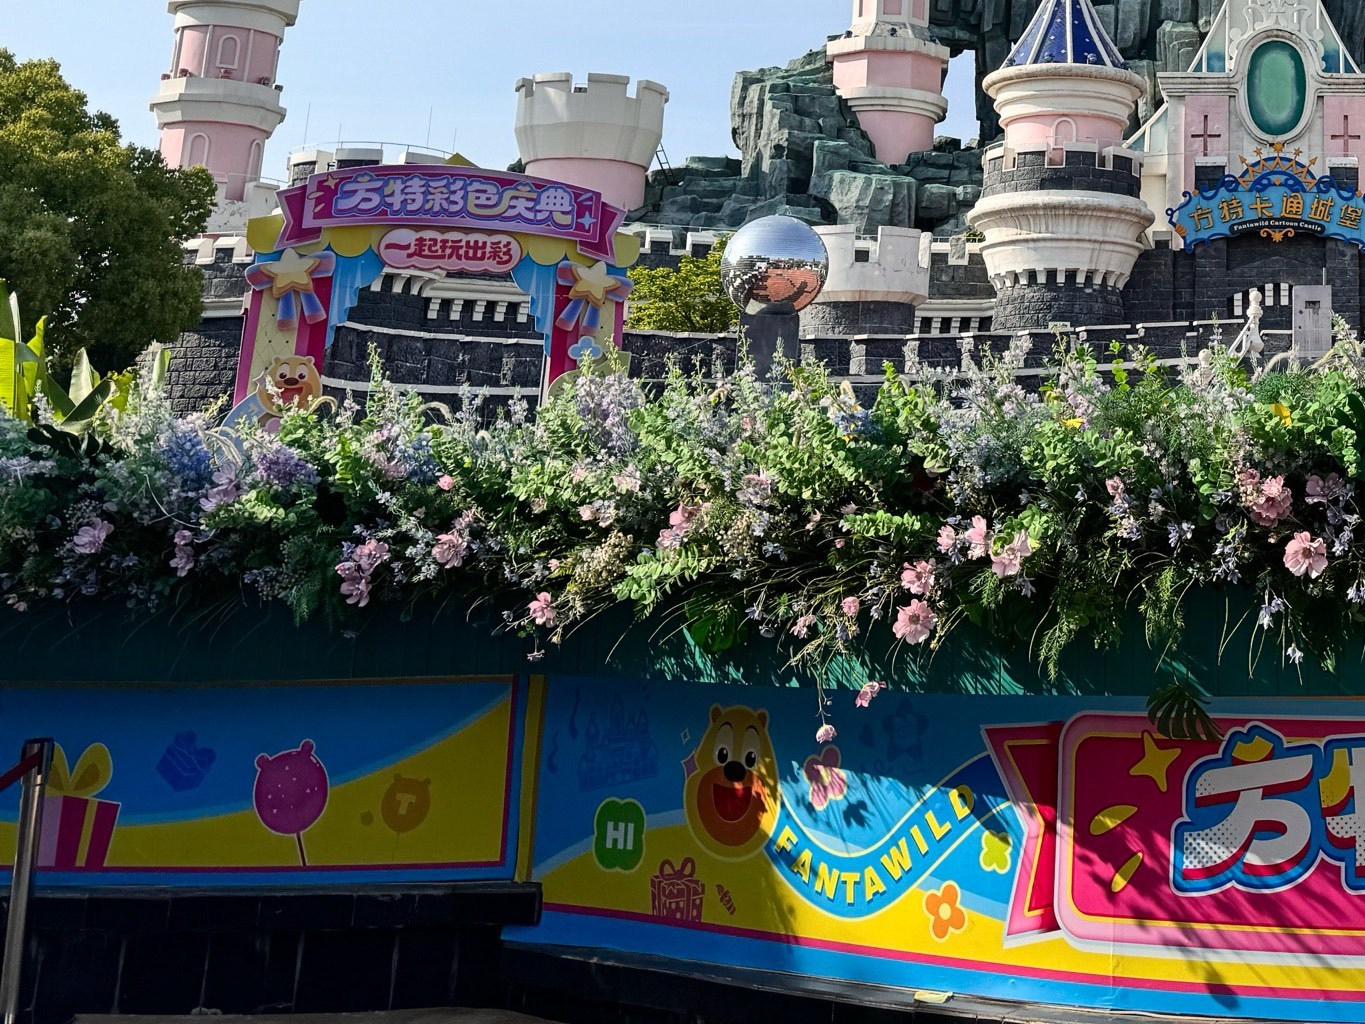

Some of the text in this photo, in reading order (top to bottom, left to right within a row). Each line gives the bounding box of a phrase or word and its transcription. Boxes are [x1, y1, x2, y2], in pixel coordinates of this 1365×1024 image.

[336, 175, 573, 227] 方特彩色庆典
[1190, 192, 1363, 229] 方特卡通城堡
[1233, 219, 1322, 231] Fantawild Cartoon Castle
[384, 237, 513, 265] 一起玩出彩
[606, 820, 635, 852] HI
[774, 784, 975, 907] FANTAWILD
